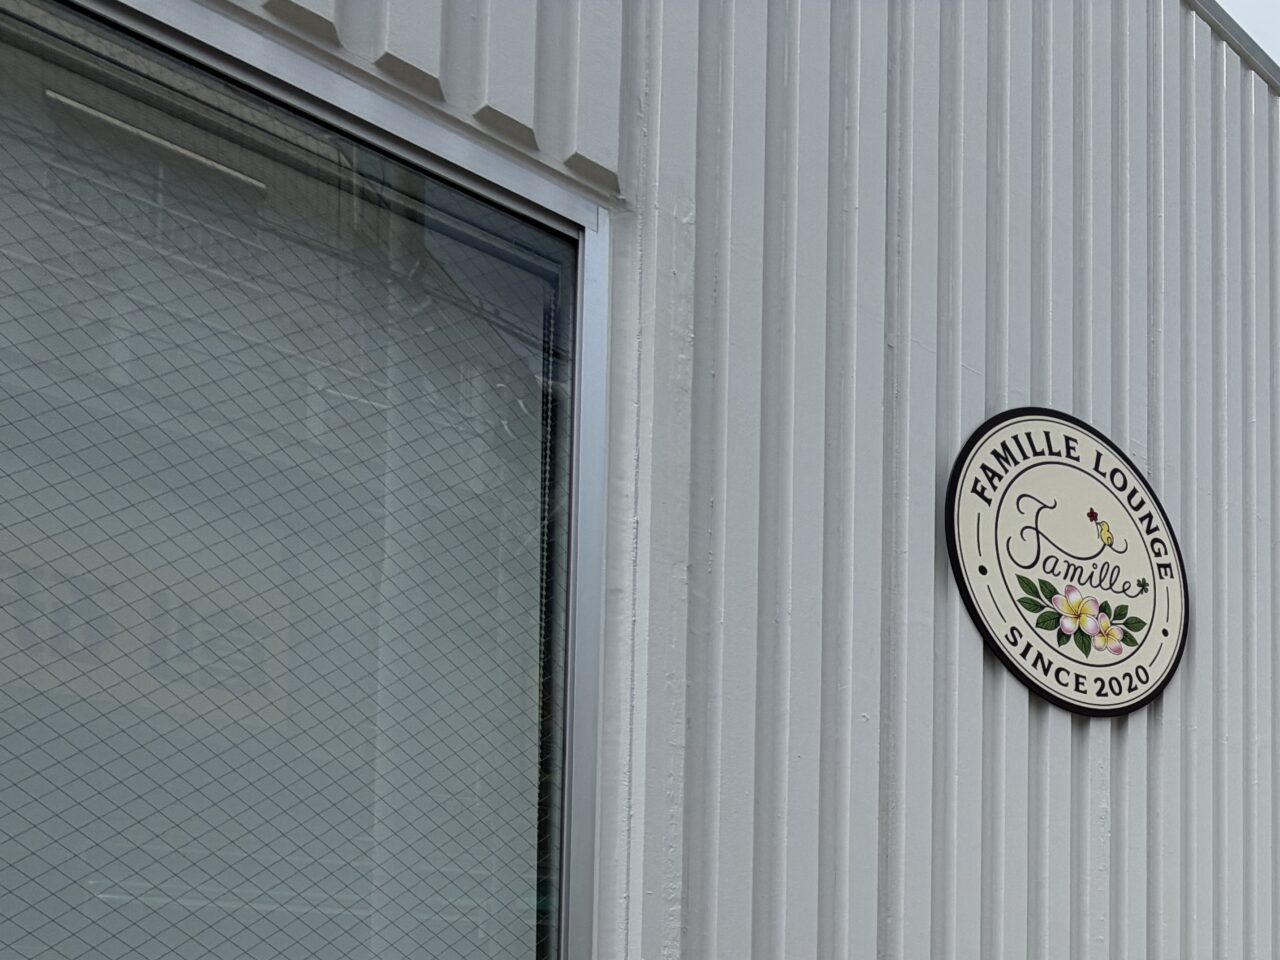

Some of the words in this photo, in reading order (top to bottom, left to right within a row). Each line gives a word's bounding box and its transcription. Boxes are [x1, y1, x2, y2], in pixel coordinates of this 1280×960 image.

[971, 431, 1081, 507] FAMILLE
[1092, 450, 1174, 580] LOUNGE
[1006, 493, 1149, 598] Famille
[1005, 626, 1088, 695] SINCE
[1094, 665, 1150, 697] 2020
